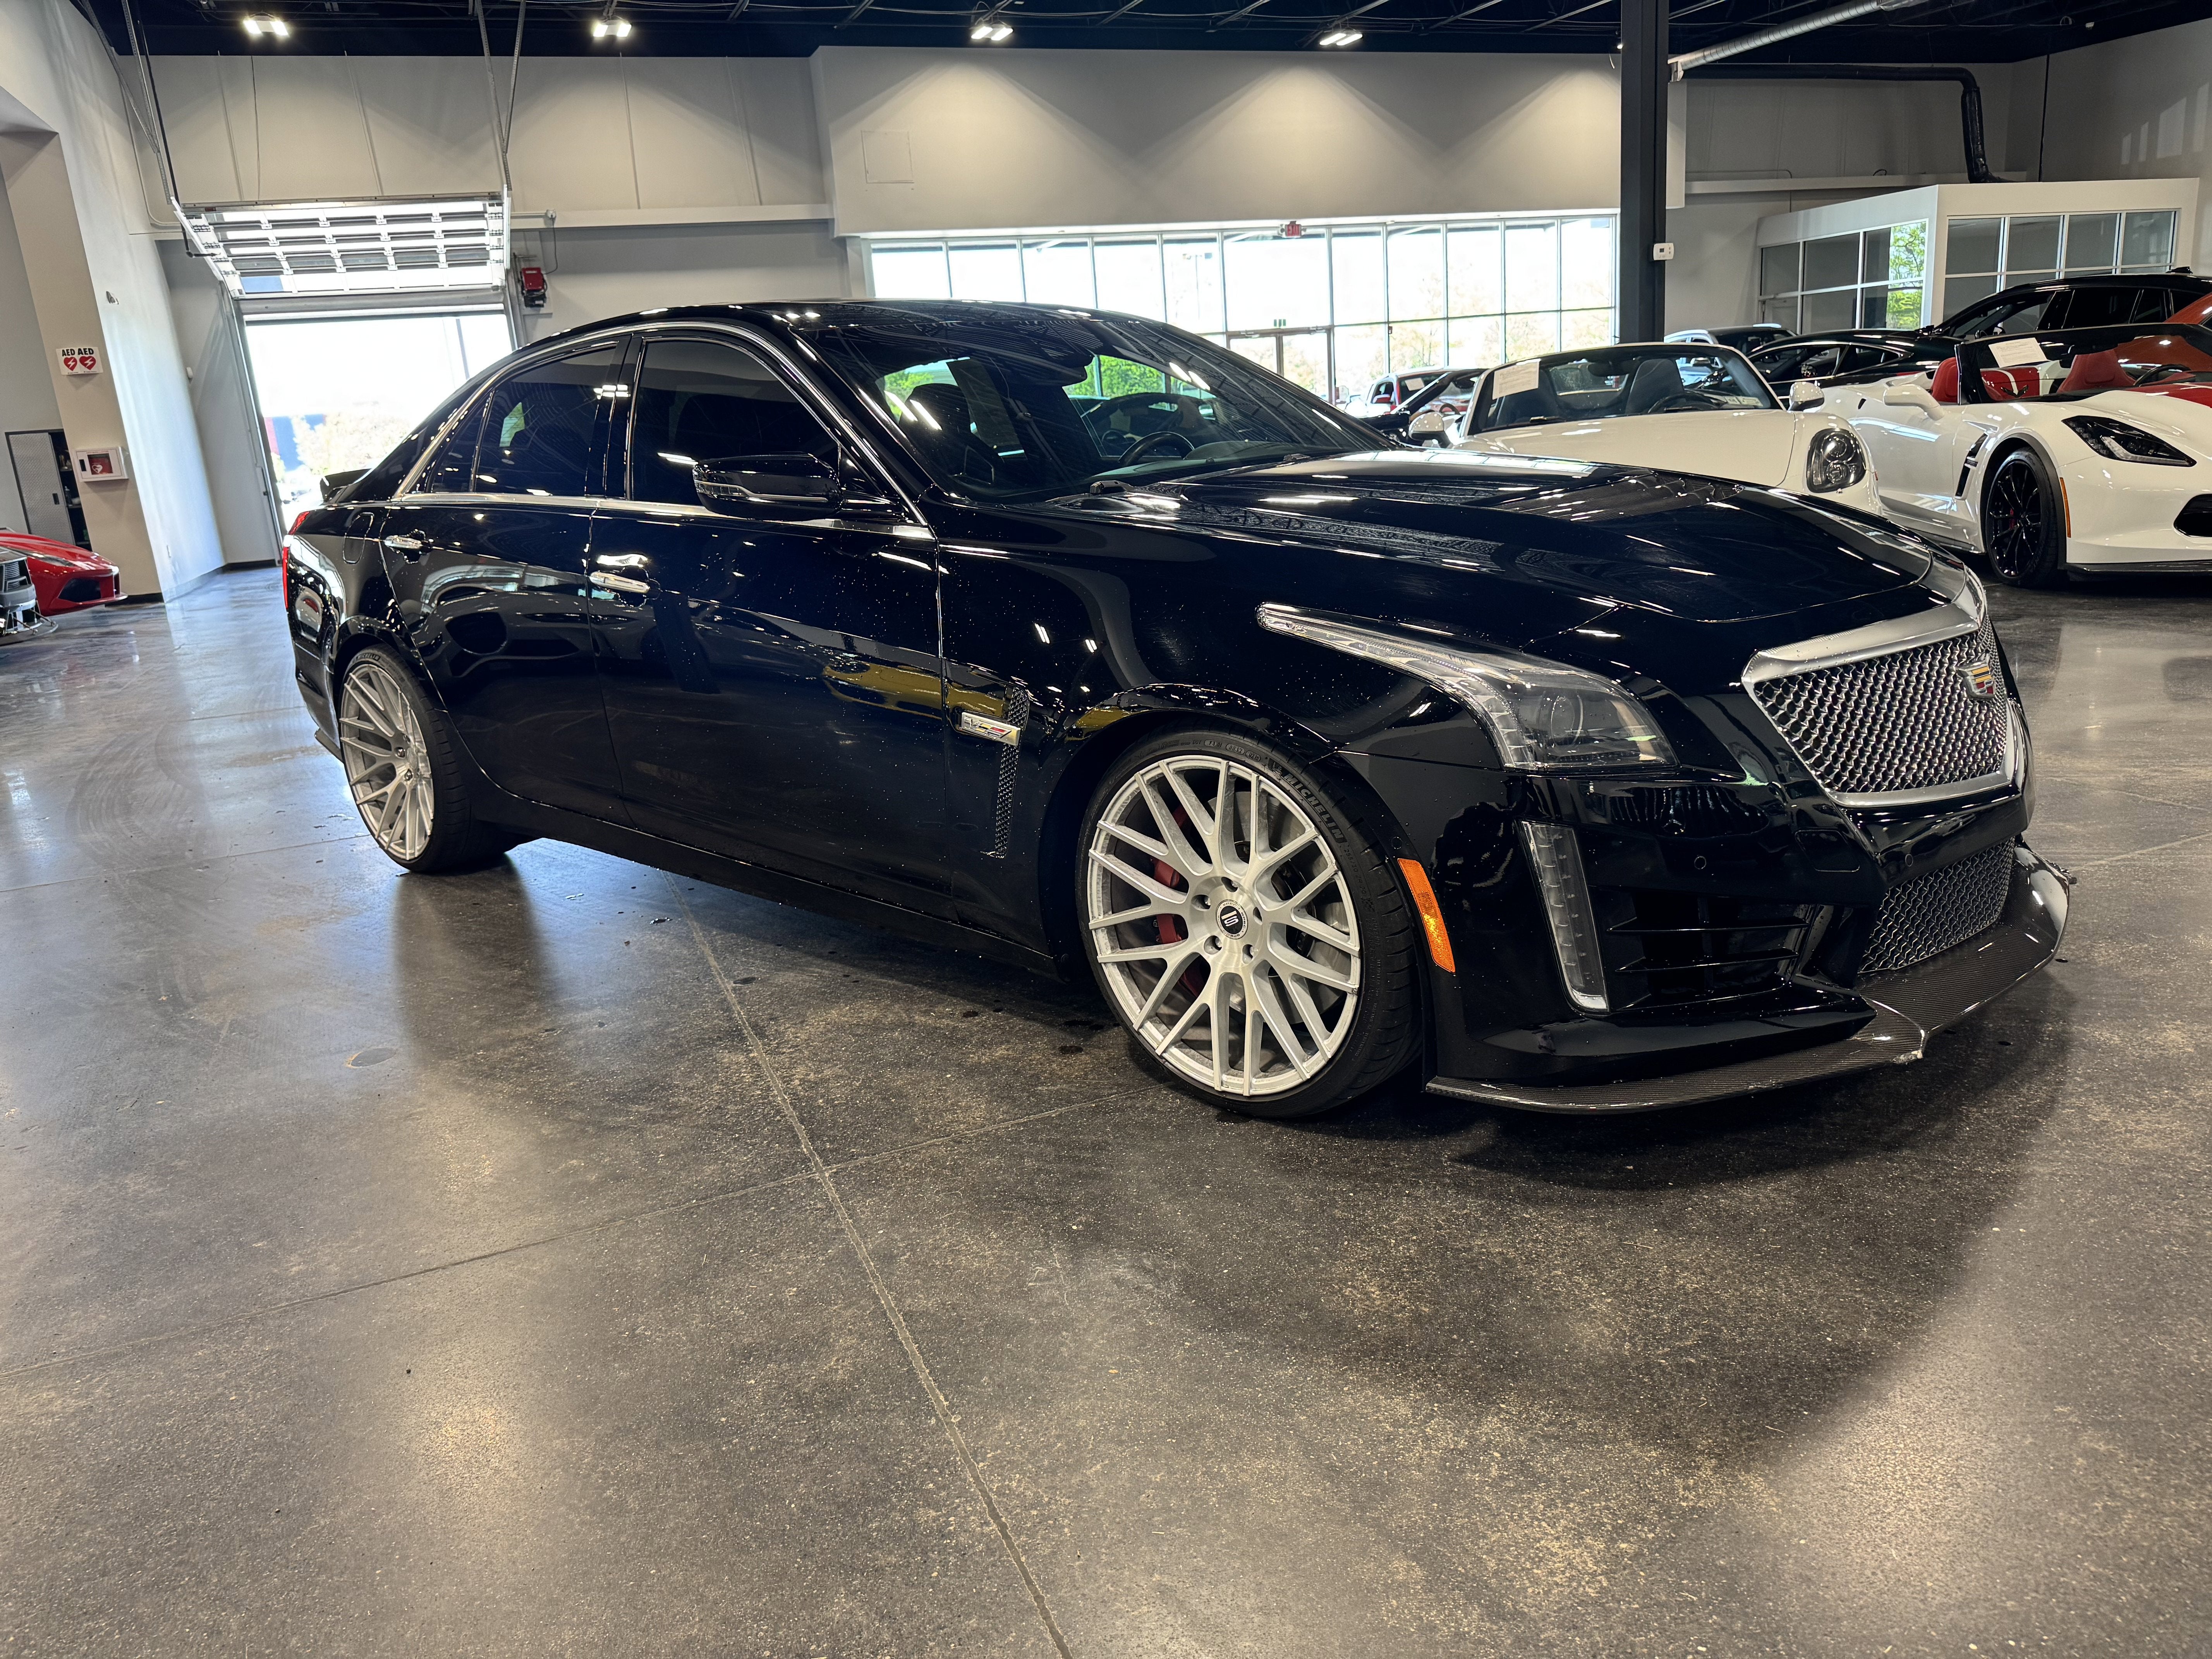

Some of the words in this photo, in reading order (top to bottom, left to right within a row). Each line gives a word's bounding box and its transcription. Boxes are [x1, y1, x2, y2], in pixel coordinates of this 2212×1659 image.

[62, 349, 76, 357] AED
[1284, 773, 1344, 839] MICHELIN
[1344, 849, 1358, 872] 255/30
